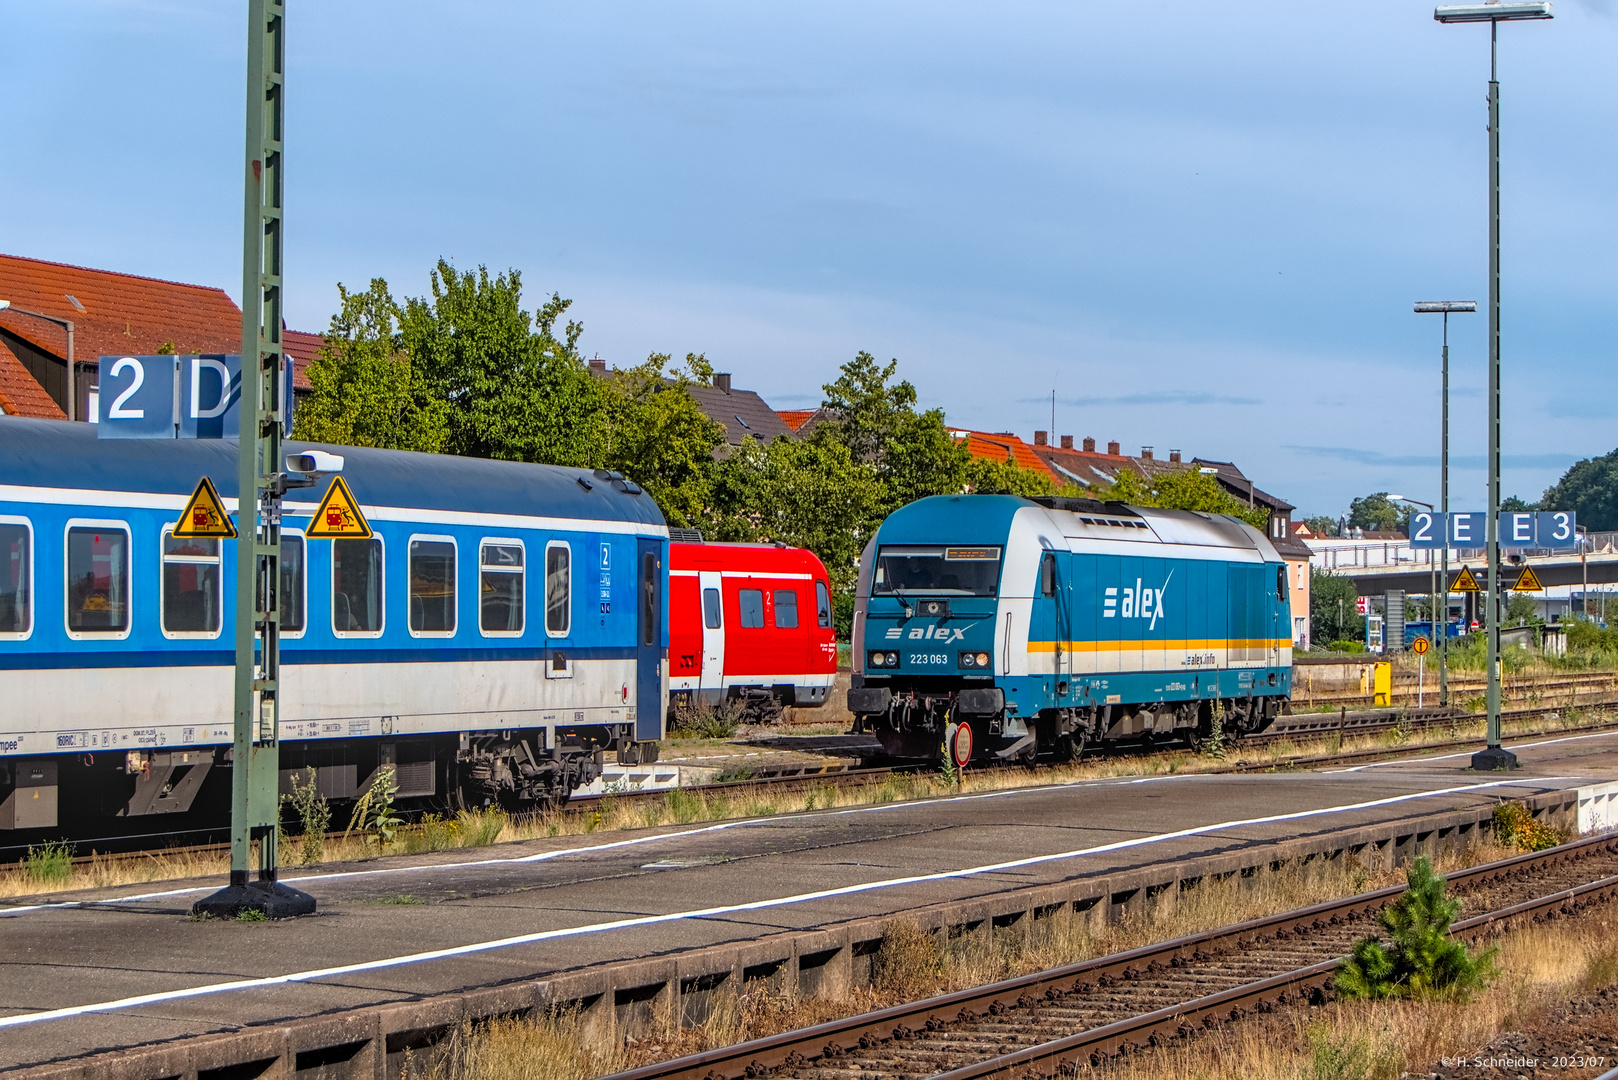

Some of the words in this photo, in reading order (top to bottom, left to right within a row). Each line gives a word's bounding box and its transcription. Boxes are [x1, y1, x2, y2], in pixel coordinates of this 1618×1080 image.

[109, 357, 144, 419] 2
[190, 359, 231, 418] D
[1414, 513, 1433, 541] 2
[1453, 514, 1471, 541] E
[1512, 513, 1530, 541] E
[1552, 512, 1570, 541] 3
[603, 548, 609, 565] 2
[766, 591, 771, 605] 2
[1122, 567, 1175, 631] alex
[908, 621, 980, 644] alex
[910, 654, 928, 664] 223
[930, 654, 948, 664] 063
